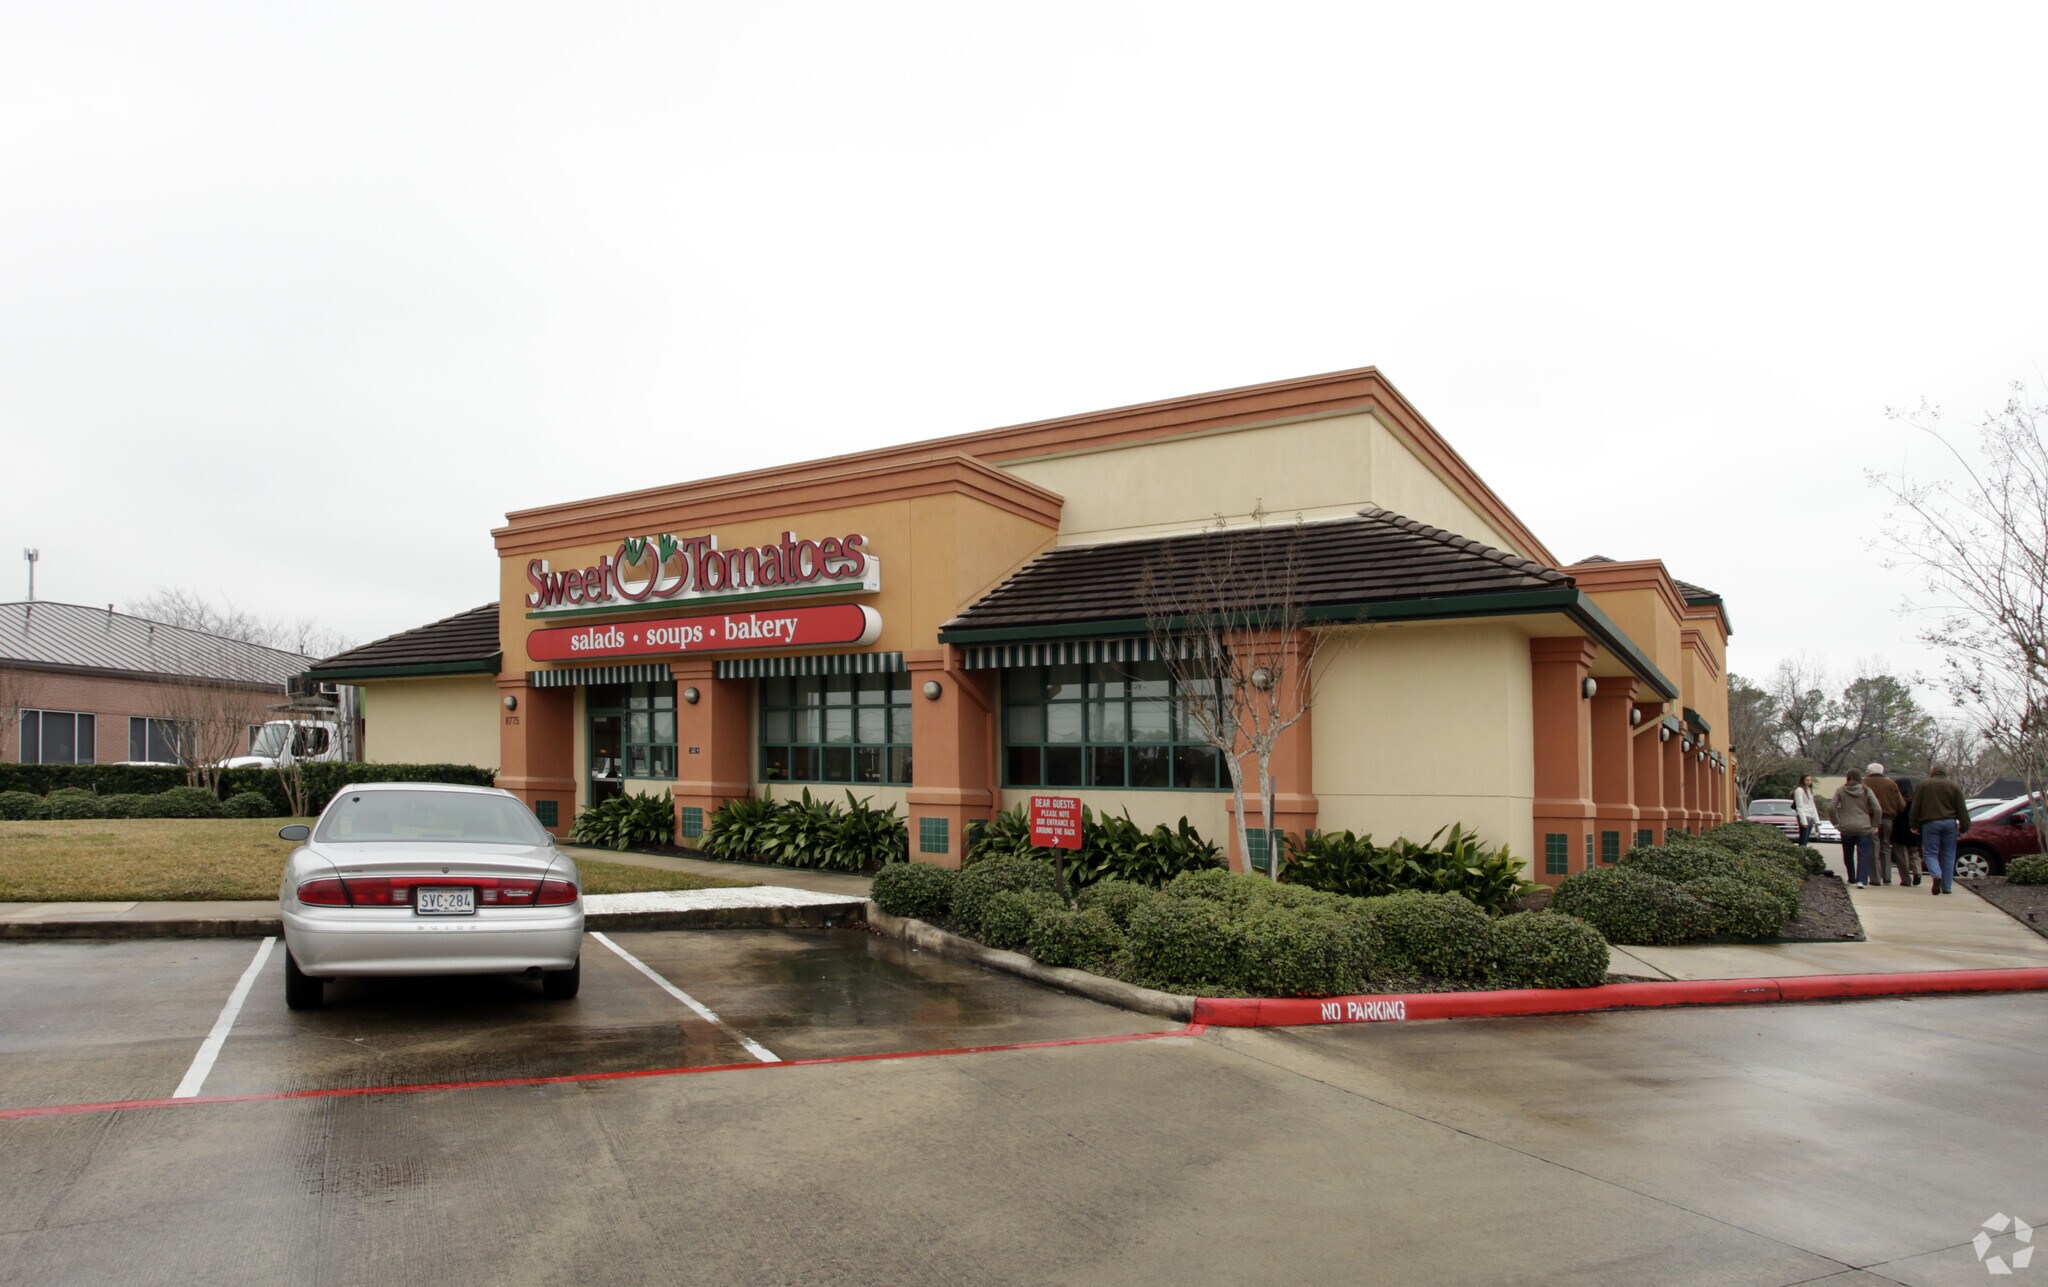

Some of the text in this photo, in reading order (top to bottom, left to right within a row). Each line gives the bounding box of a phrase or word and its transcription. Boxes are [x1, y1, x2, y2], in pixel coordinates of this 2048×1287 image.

[526, 531, 865, 608] Sweet Tomatoes
[571, 614, 798, 650] salads soups bakery
[505, 716, 520, 726] 8775
[1035, 798, 1050, 808] DEAR
[1041, 809, 1070, 818] PLEASE NOTE
[1047, 818, 1068, 827] ENTRANCE
[1036, 826, 1053, 834] AROUND
[1064, 828, 1076, 836] BACK
[1321, 1000, 1406, 1021] NO PARKING
